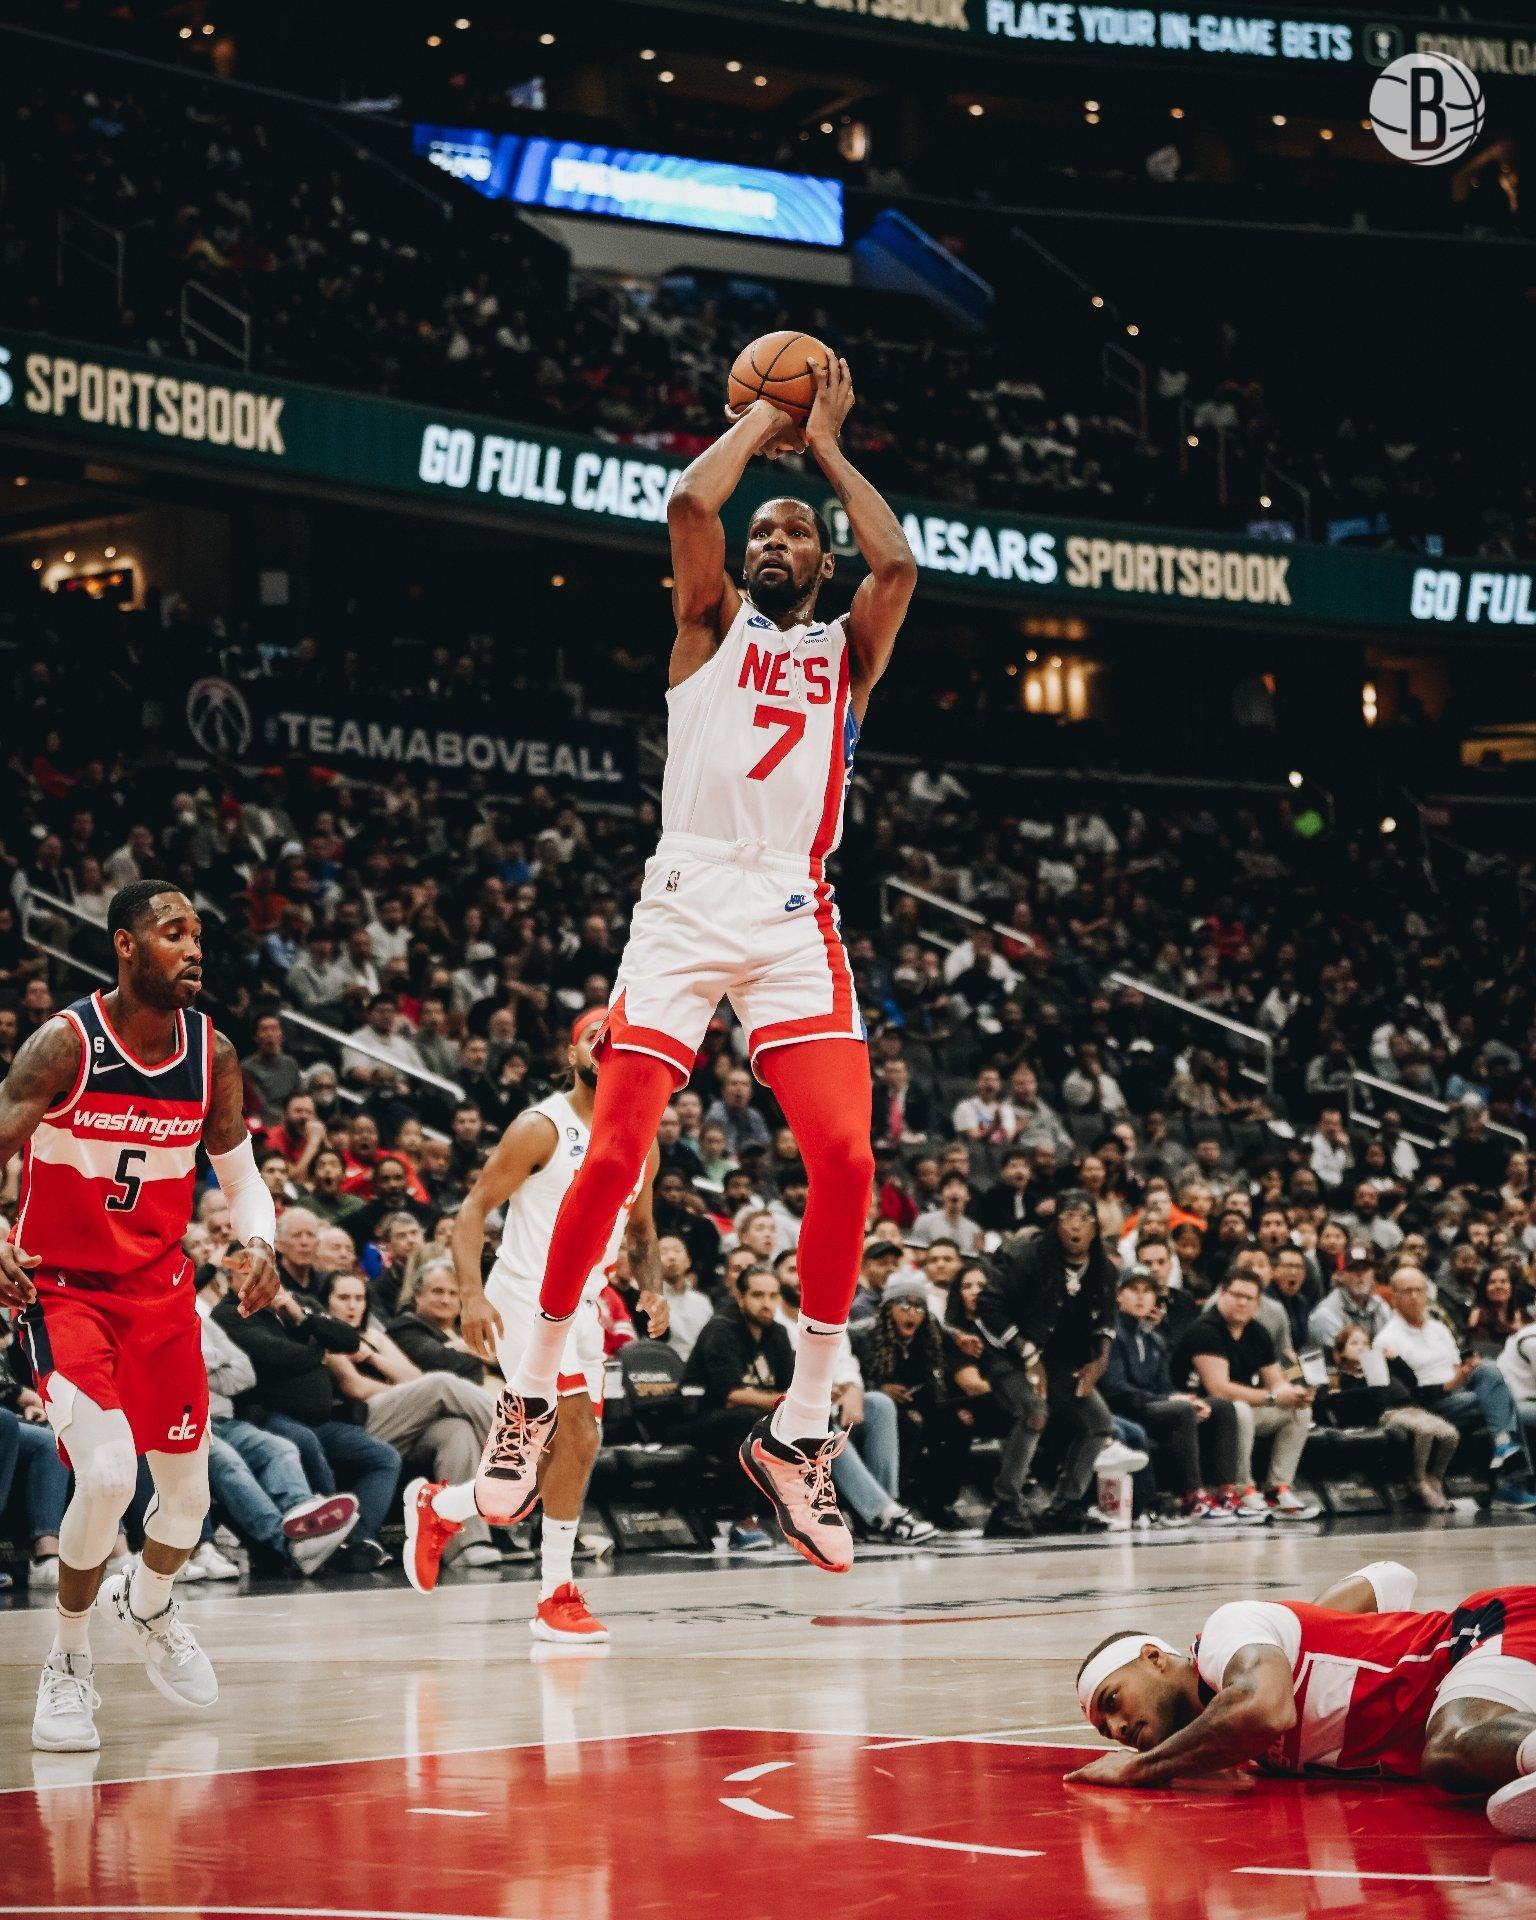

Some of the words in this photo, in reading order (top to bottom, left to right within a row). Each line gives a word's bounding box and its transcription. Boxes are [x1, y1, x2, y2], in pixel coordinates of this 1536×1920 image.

[986, 0, 1075, 41] PLACE
[1079, 5, 1156, 48] YOUR
[1160, 11, 1277, 57] IN-GAME
[1281, 20, 1353, 62] BETS
[25, 353, 286, 455] SPORTSBOOK
[419, 424, 475, 488] GO
[477, 435, 566, 505] FULL
[903, 513, 1058, 585] AESARS
[1065, 536, 1291, 605] SPORTSBOOK
[1411, 568, 1462, 621] GO
[738, 642, 832, 705] NES
[746, 704, 807, 781] 7
[93, 1036, 105, 1053] 6
[73, 1104, 204, 1142] washington
[105, 1148, 147, 1213] 5
